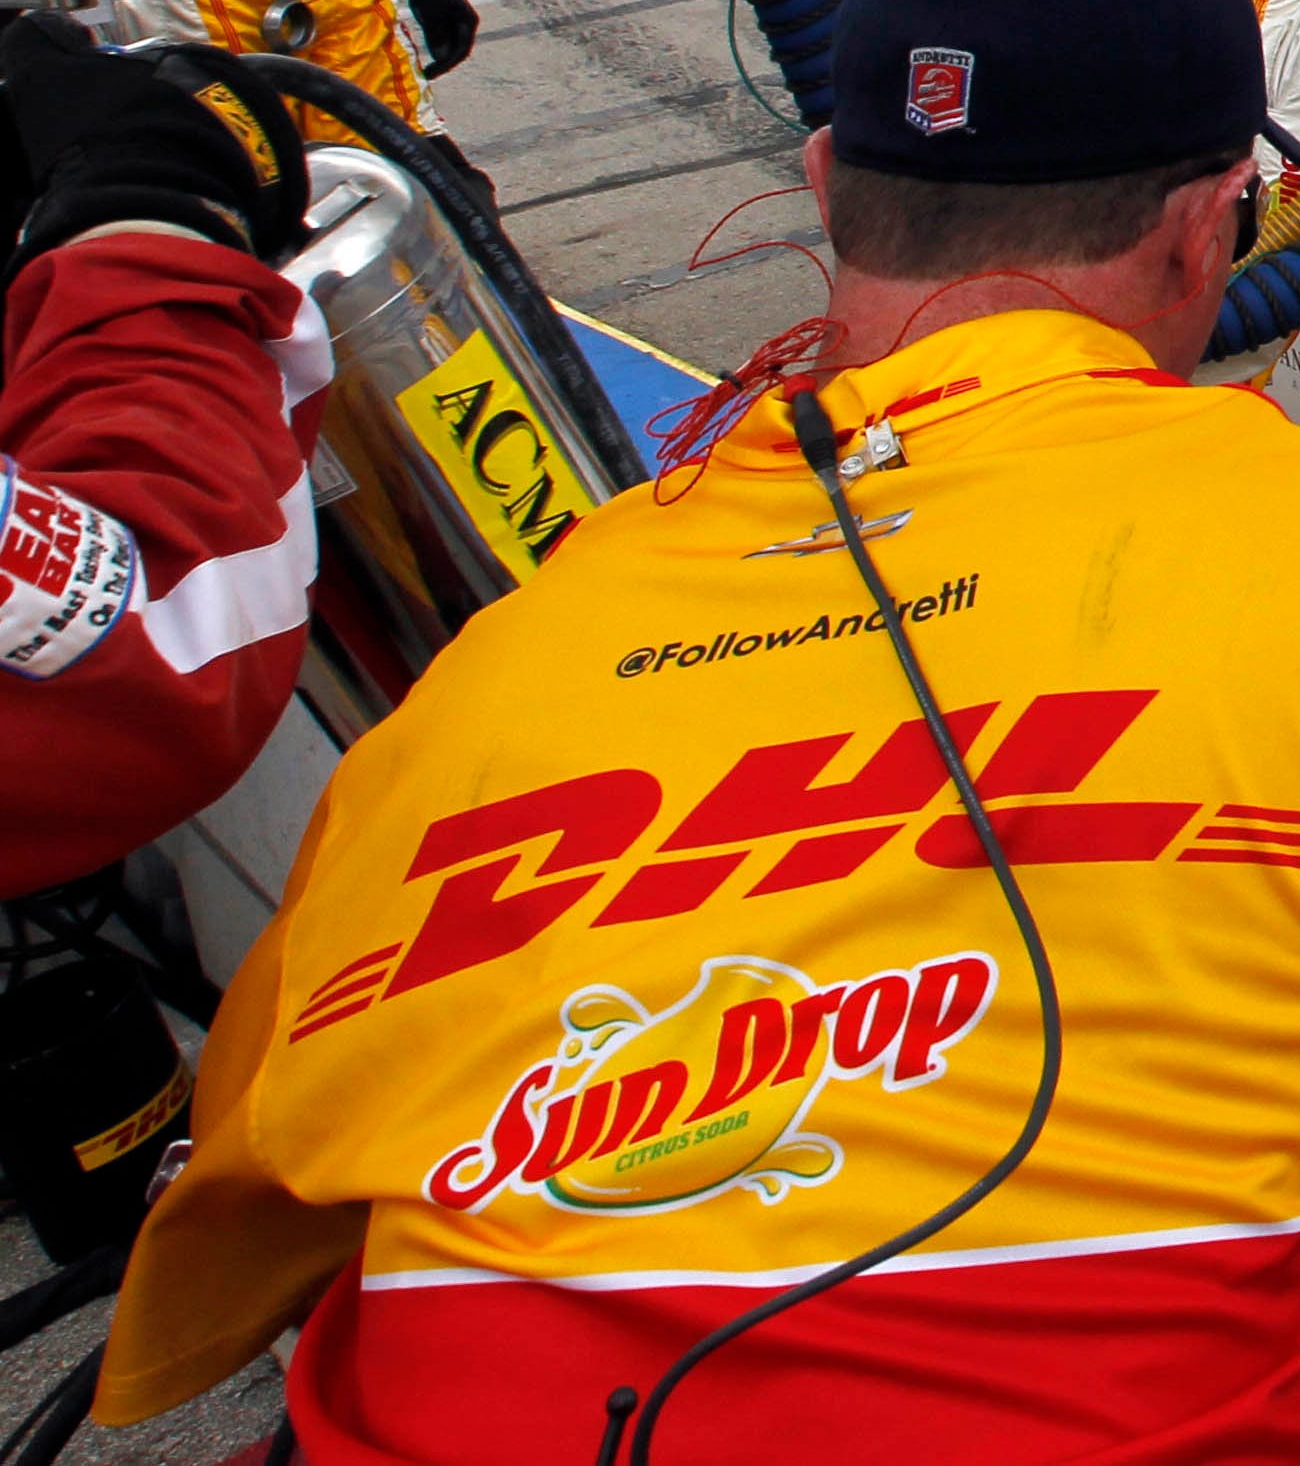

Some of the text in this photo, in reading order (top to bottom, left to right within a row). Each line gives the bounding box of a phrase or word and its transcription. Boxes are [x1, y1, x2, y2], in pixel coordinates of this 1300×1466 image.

[615, 573, 980, 680] @FollowAndretti
[382, 688, 1204, 1002] DHL
[429, 957, 991, 1212] Sun Drop
[613, 1109, 752, 1174] CITRUS SODA
